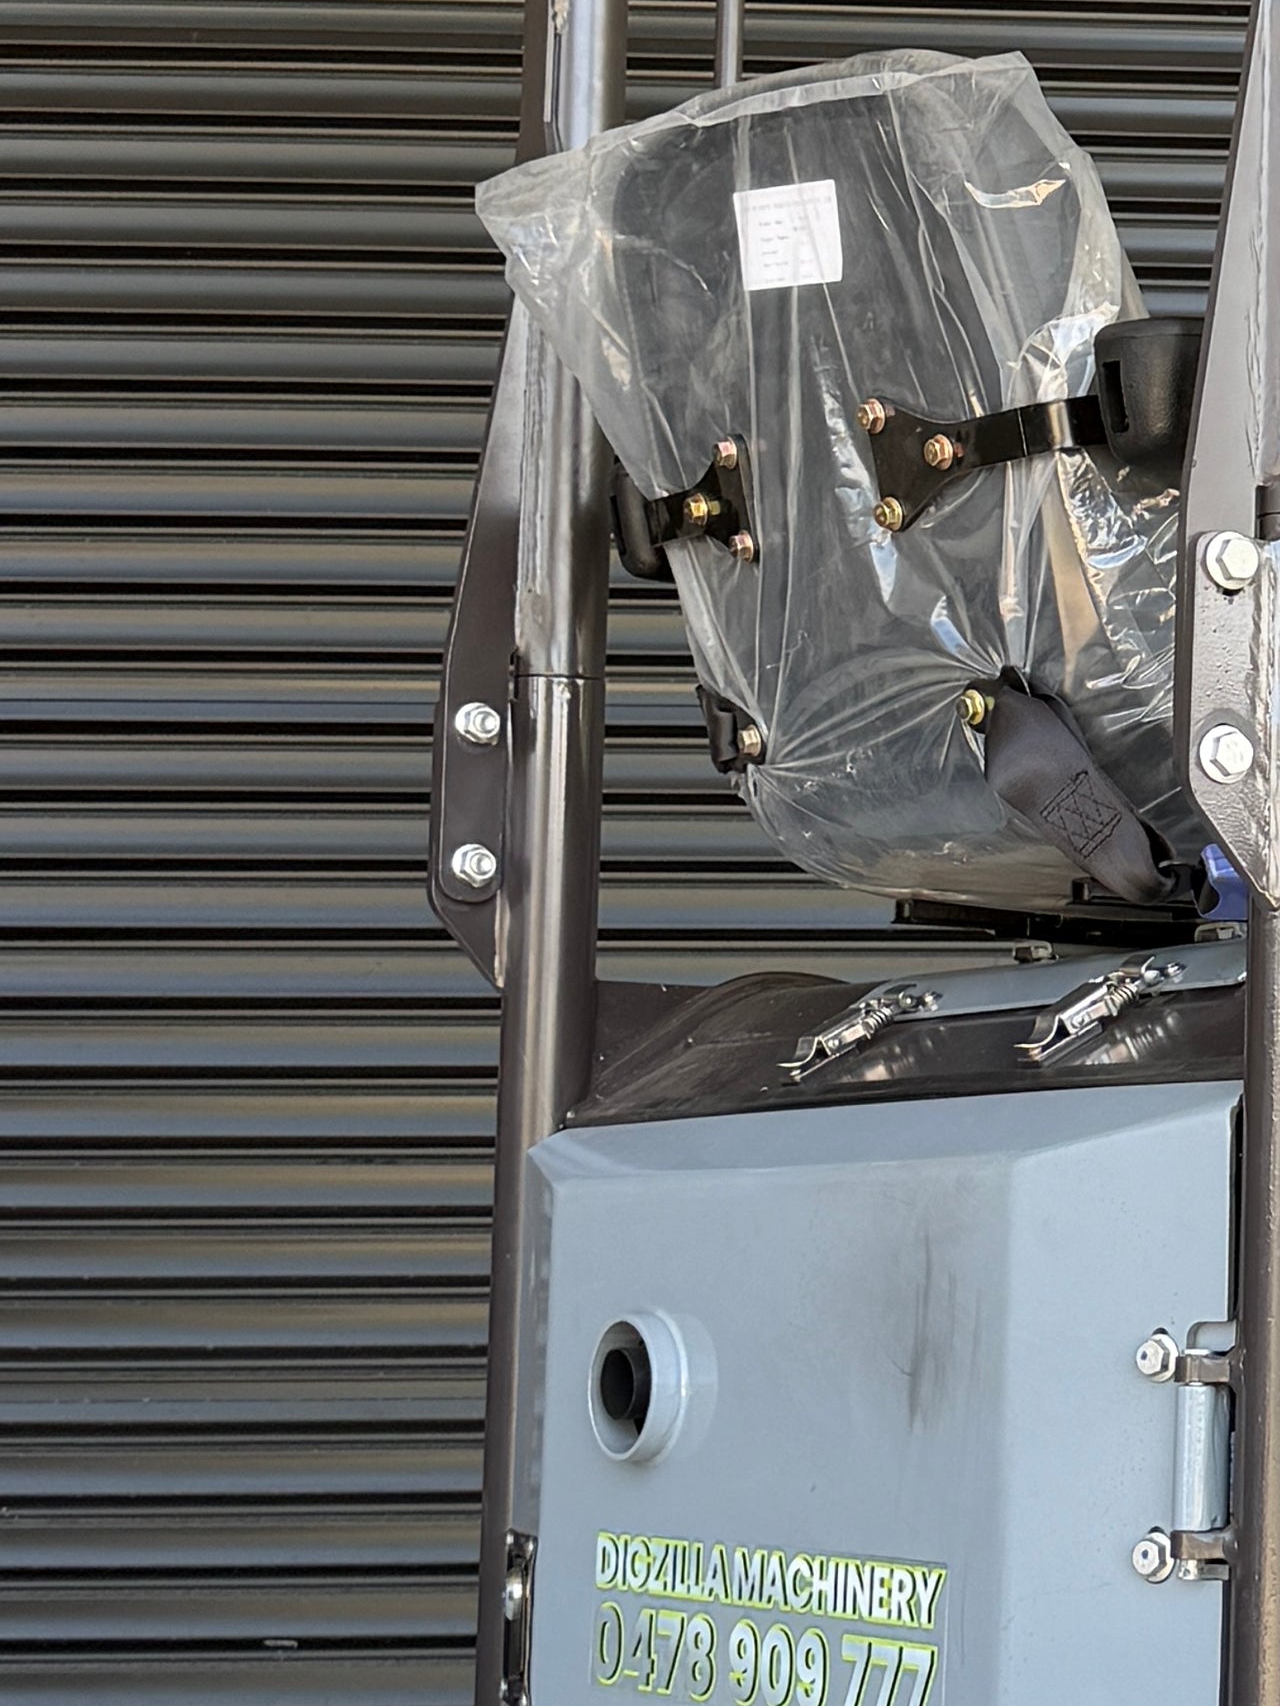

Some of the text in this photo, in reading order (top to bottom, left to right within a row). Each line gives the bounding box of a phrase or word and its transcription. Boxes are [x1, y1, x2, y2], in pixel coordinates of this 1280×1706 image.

[595, 1532, 948, 1629] DIGZILLA MACHINERY
[597, 1601, 717, 1703] 0478
